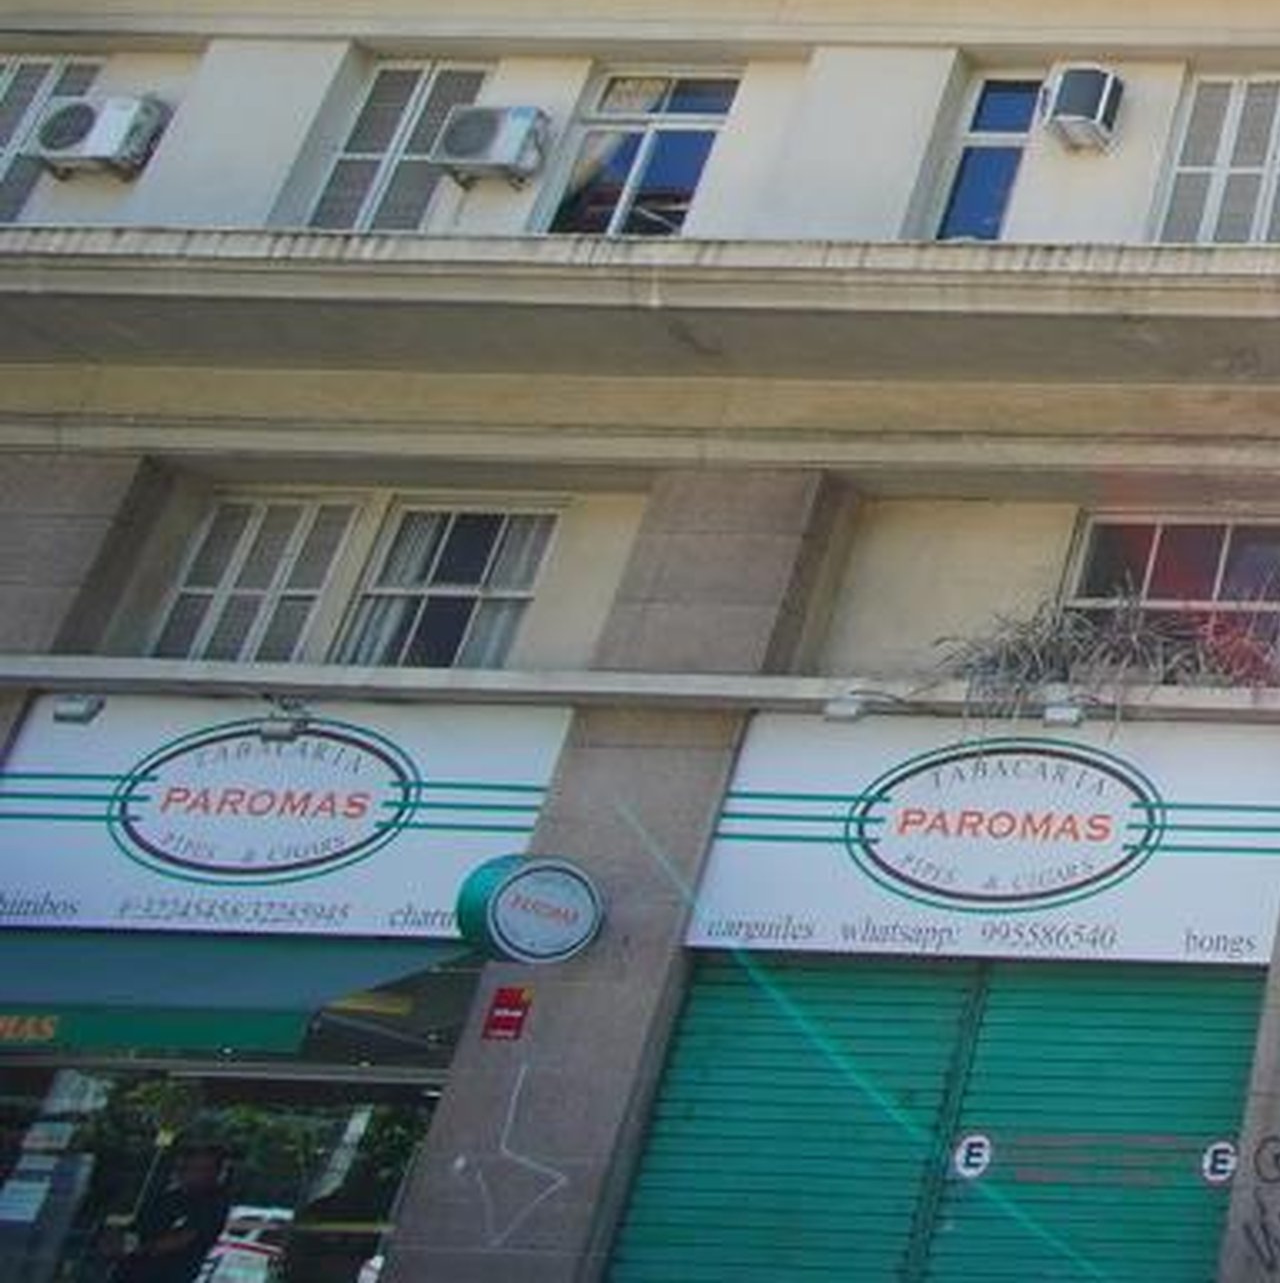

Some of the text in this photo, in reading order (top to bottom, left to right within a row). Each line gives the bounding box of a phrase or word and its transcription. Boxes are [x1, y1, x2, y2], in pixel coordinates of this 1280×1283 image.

[930, 759, 1114, 797] TABACARIA
[159, 786, 372, 819] PAROMAS
[897, 808, 1115, 842] PAROMAS
